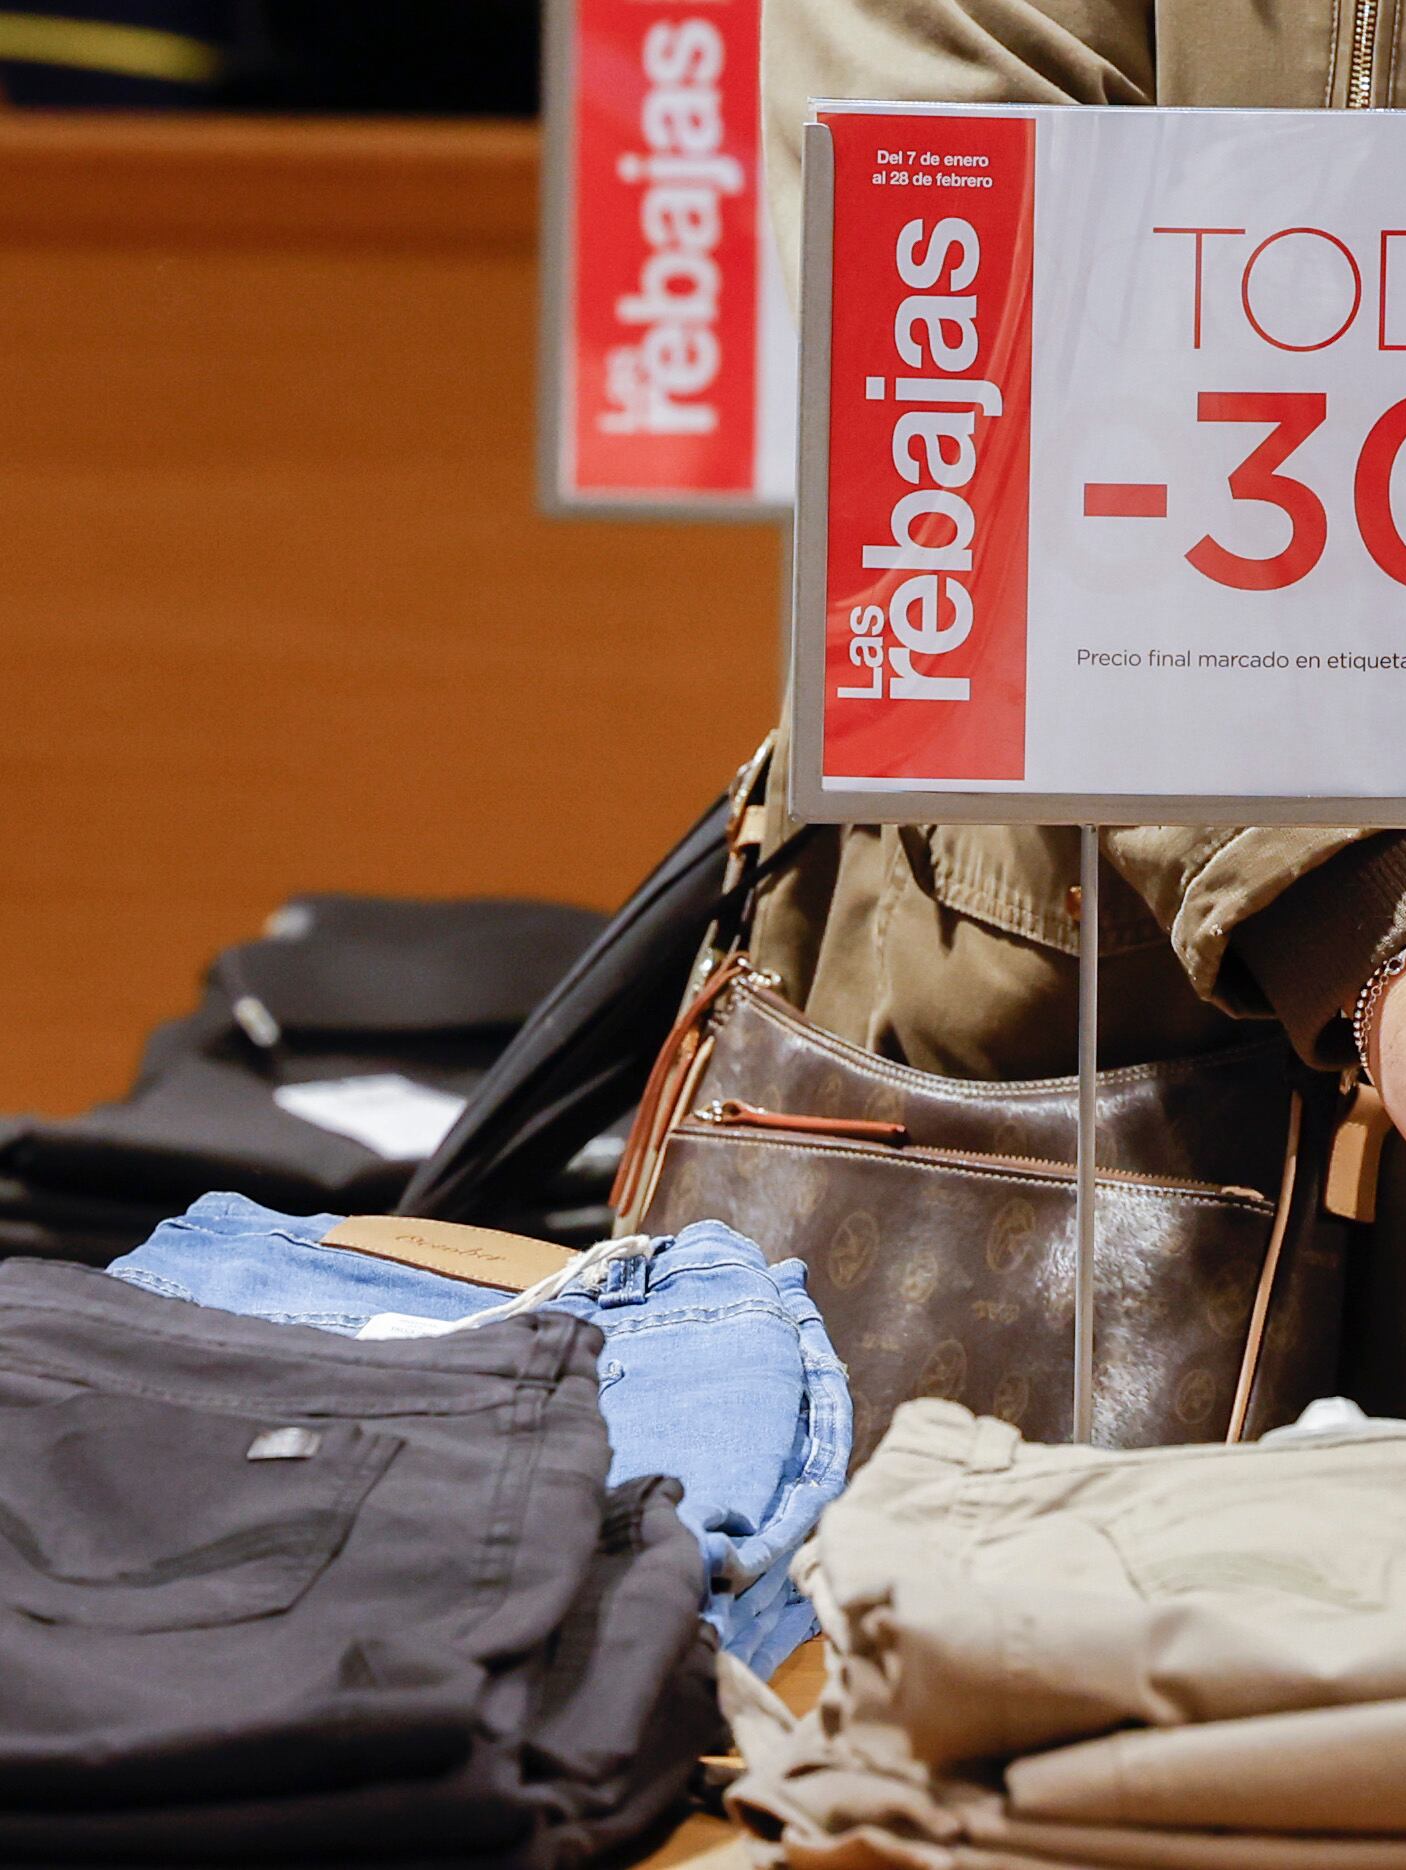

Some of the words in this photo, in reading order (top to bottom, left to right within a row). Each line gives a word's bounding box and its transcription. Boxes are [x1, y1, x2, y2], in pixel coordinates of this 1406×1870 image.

[872, 170, 886, 185] al
[890, 171, 909, 186] 28
[912, 172, 933, 186] de
[935, 172, 993, 188] febrero
[877, 149, 903, 165] Del
[906, 151, 917, 165] 7
[920, 151, 940, 166] de
[943, 155, 989, 167] enero
[615, 17, 745, 437] rebajas
[862, 215, 1003, 702] rebajas
[836, 604, 885, 699] Las
[1077, 648, 1142, 667] Precio
[1148, 649, 1191, 668] final
[1198, 651, 1290, 669] marcado
[1296, 655, 1321, 669] en
